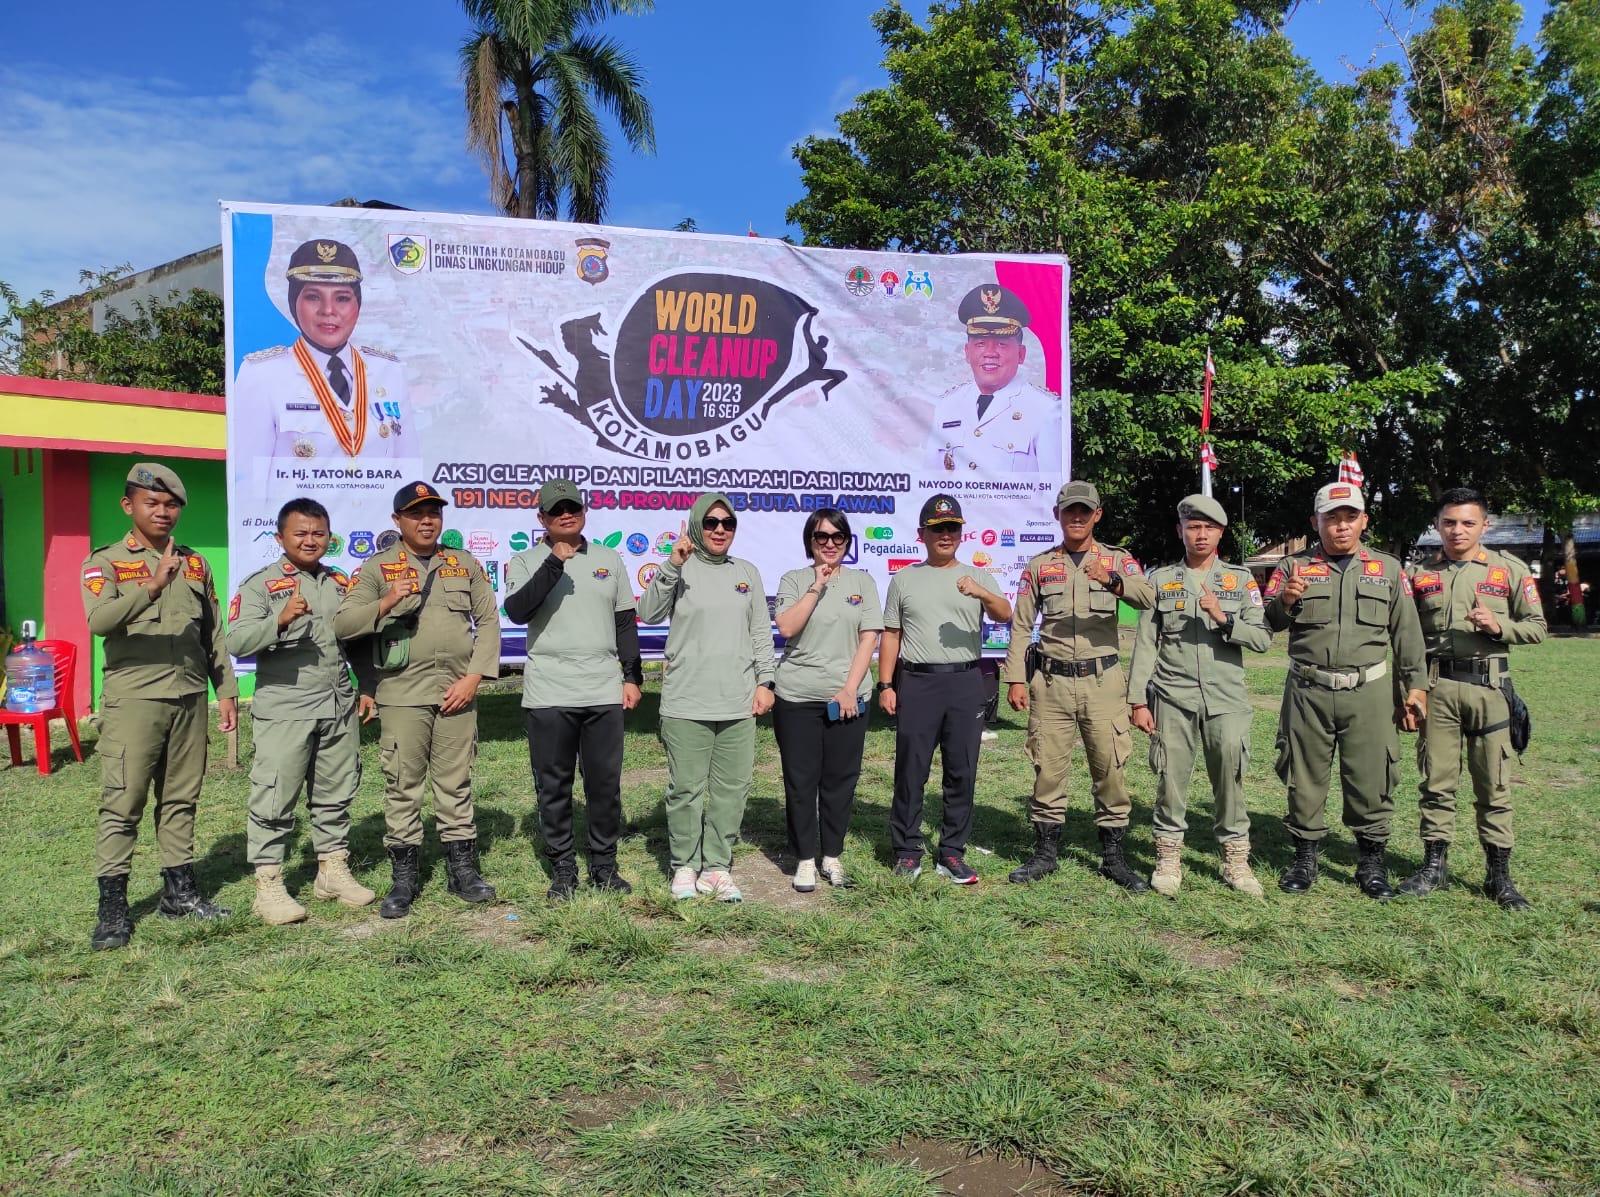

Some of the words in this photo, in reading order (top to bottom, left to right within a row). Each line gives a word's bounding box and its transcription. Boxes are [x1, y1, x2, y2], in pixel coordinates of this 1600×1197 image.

[434, 243, 498, 258] PEMERINTAH
[500, 246, 566, 261] KOTAMOBAGU
[434, 255, 467, 269] DINAS
[468, 257, 533, 273] LINGKUNGAN
[535, 260, 566, 275] HIDUP
[655, 289, 757, 335] WORLD
[648, 333, 779, 380] CLEANUP
[644, 377, 704, 420] DAY
[702, 382, 742, 403] 2023
[702, 403, 717, 418] 16
[718, 403, 740, 419] SEP
[592, 402, 765, 461] KOTAMOBAGU
[276, 469, 289, 479] Ir.
[292, 469, 309, 480] Hj.
[312, 469, 364, 479] TATONG
[366, 469, 403, 479] BARA
[434, 464, 485, 482] AKSI
[488, 465, 588, 484] CLEANUP
[592, 468, 633, 484] DAN
[641, 468, 702, 486] PILAH
[705, 470, 788, 488] SAMPAH
[791, 472, 838, 489] DARI
[841, 473, 911, 491] RUMAH
[918, 480, 963, 489] NAYODO
[965, 481, 1037, 491] KOERNIAWAN,
[1038, 483, 1052, 491] SH
[454, 489, 485, 507] 191
[489, 489, 544, 509] NEGA
[590, 491, 617, 509] 34
[620, 491, 697, 511] PROVIN
[751, 494, 800, 512] JUTA
[800, 495, 896, 514] RELAWAN
[242, 517, 252, 527] di
